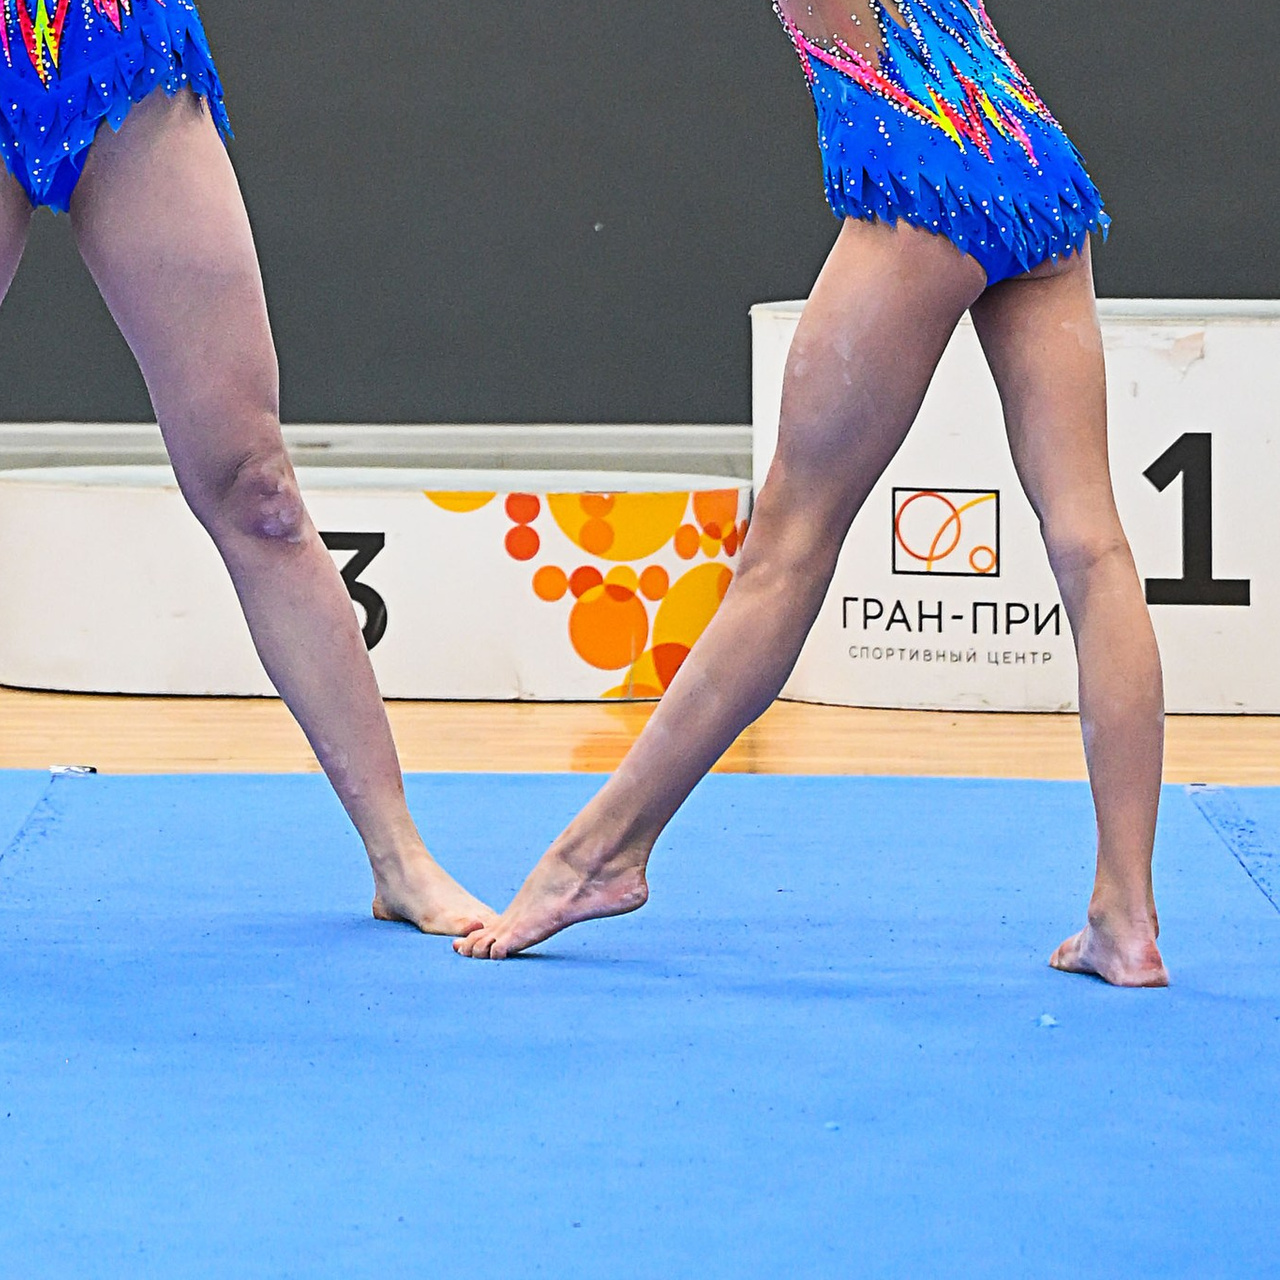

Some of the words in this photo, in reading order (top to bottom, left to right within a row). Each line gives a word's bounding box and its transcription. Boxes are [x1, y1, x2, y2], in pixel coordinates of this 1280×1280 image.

[1142, 432, 1251, 607] 1
[841, 595, 1061, 637] ГРАН-ПРИ
[847, 644, 978, 665] СПОРТИВНЫЙ
[986, 650, 1053, 667] ЦЕНТР
